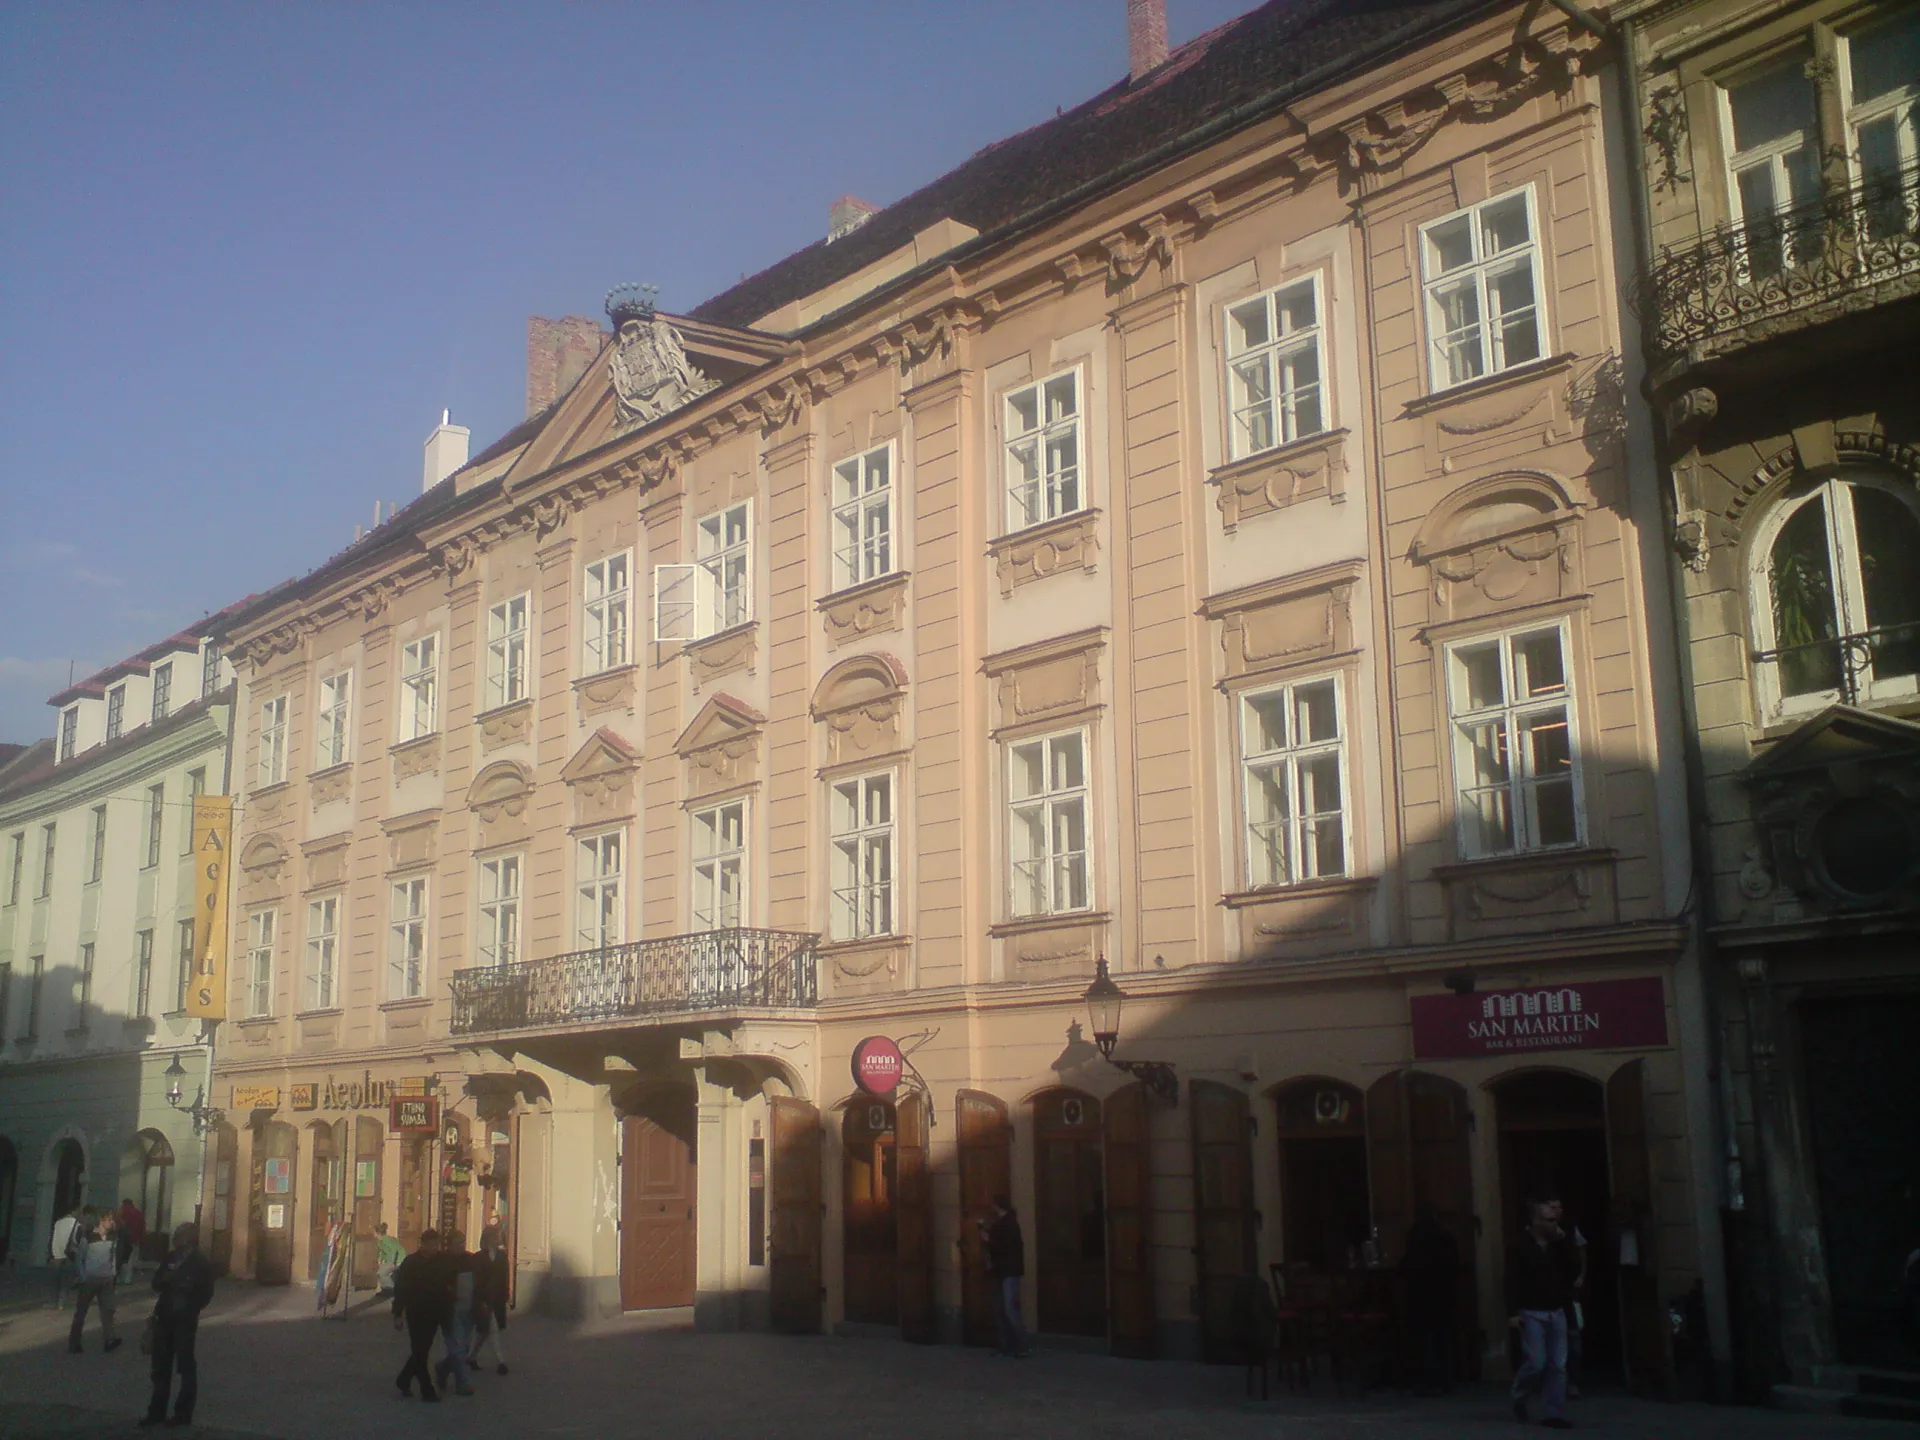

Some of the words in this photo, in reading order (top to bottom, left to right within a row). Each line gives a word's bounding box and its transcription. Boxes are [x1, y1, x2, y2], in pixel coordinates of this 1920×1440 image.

[199, 827, 224, 1007] Aeolus
[1468, 1019, 1506, 1038] SAN
[1513, 1013, 1599, 1035] MARTEN
[1486, 1040, 1505, 1049] BAR
[1516, 1034, 1583, 1048] RESTAURANT
[323, 1069, 397, 1110] Aeolus
